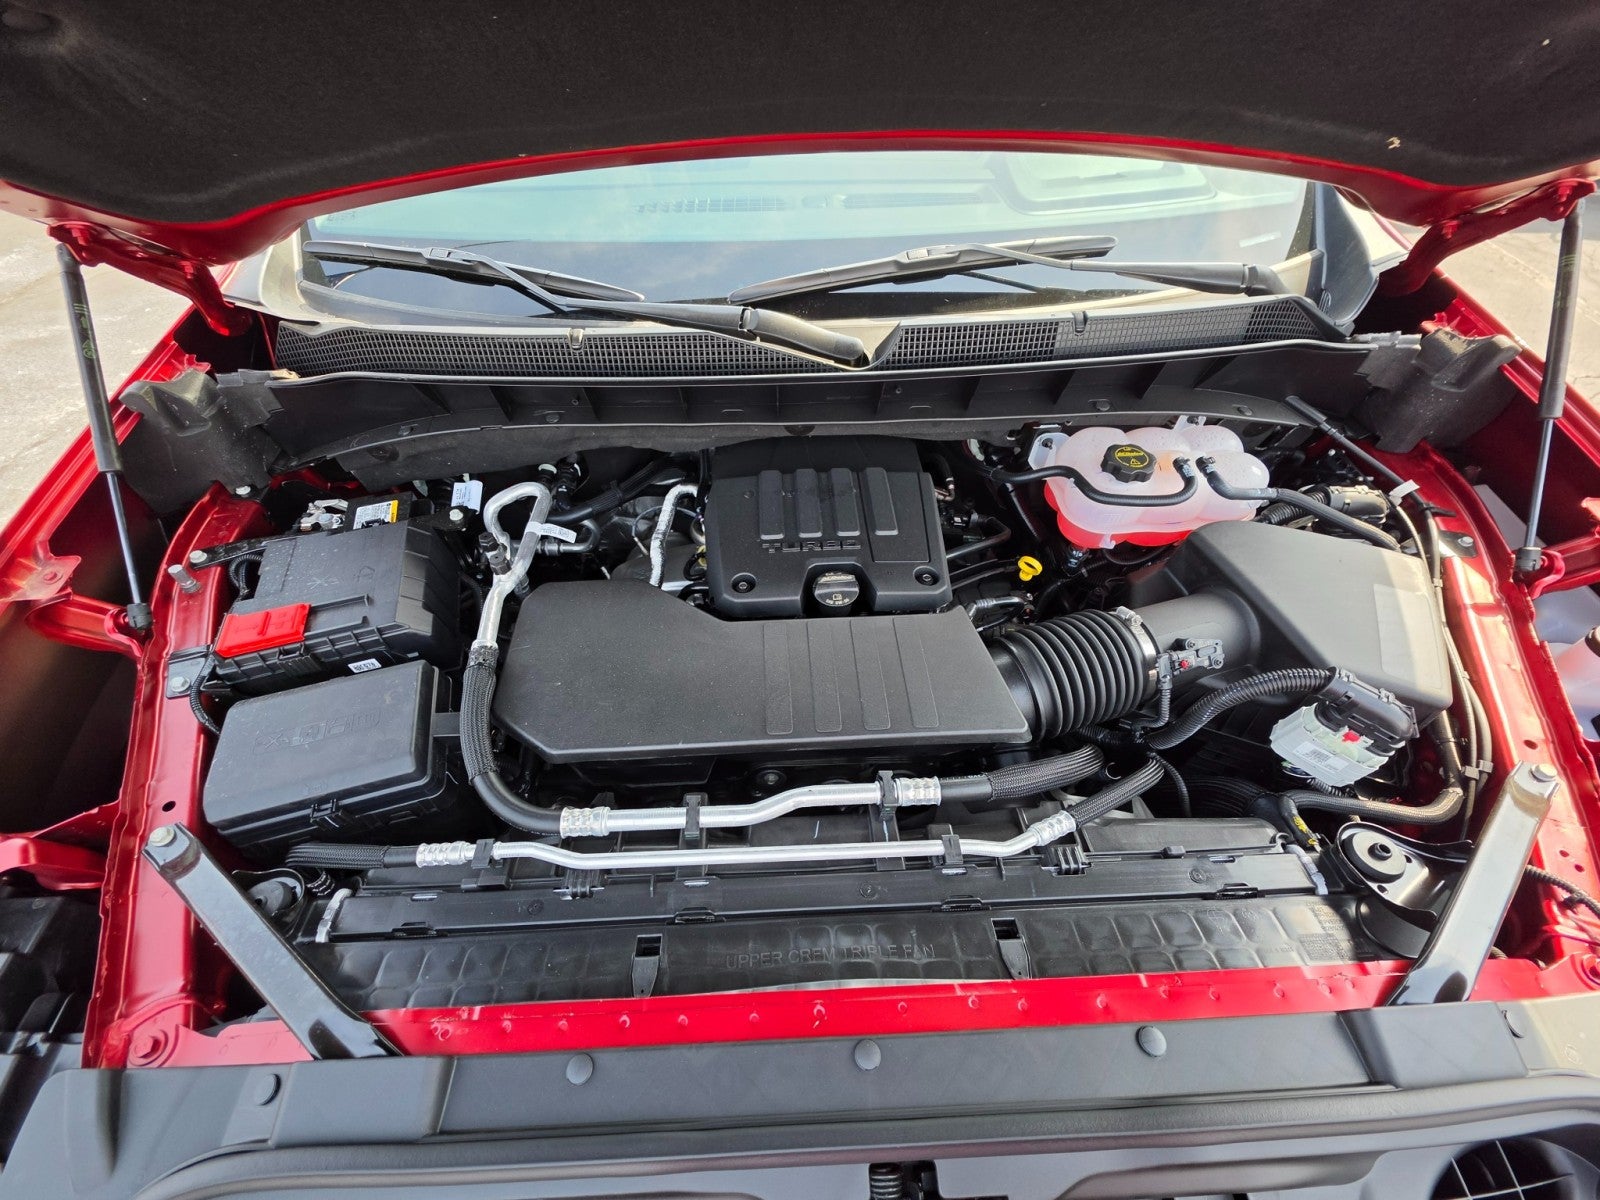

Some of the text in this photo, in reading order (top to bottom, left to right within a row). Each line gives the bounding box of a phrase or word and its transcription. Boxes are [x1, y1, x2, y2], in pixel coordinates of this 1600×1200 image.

[762, 540, 861, 553] TURBO
[726, 951, 783, 969] UPPER
[842, 944, 897, 960] TRIPLE
[902, 943, 936, 960] FAN
